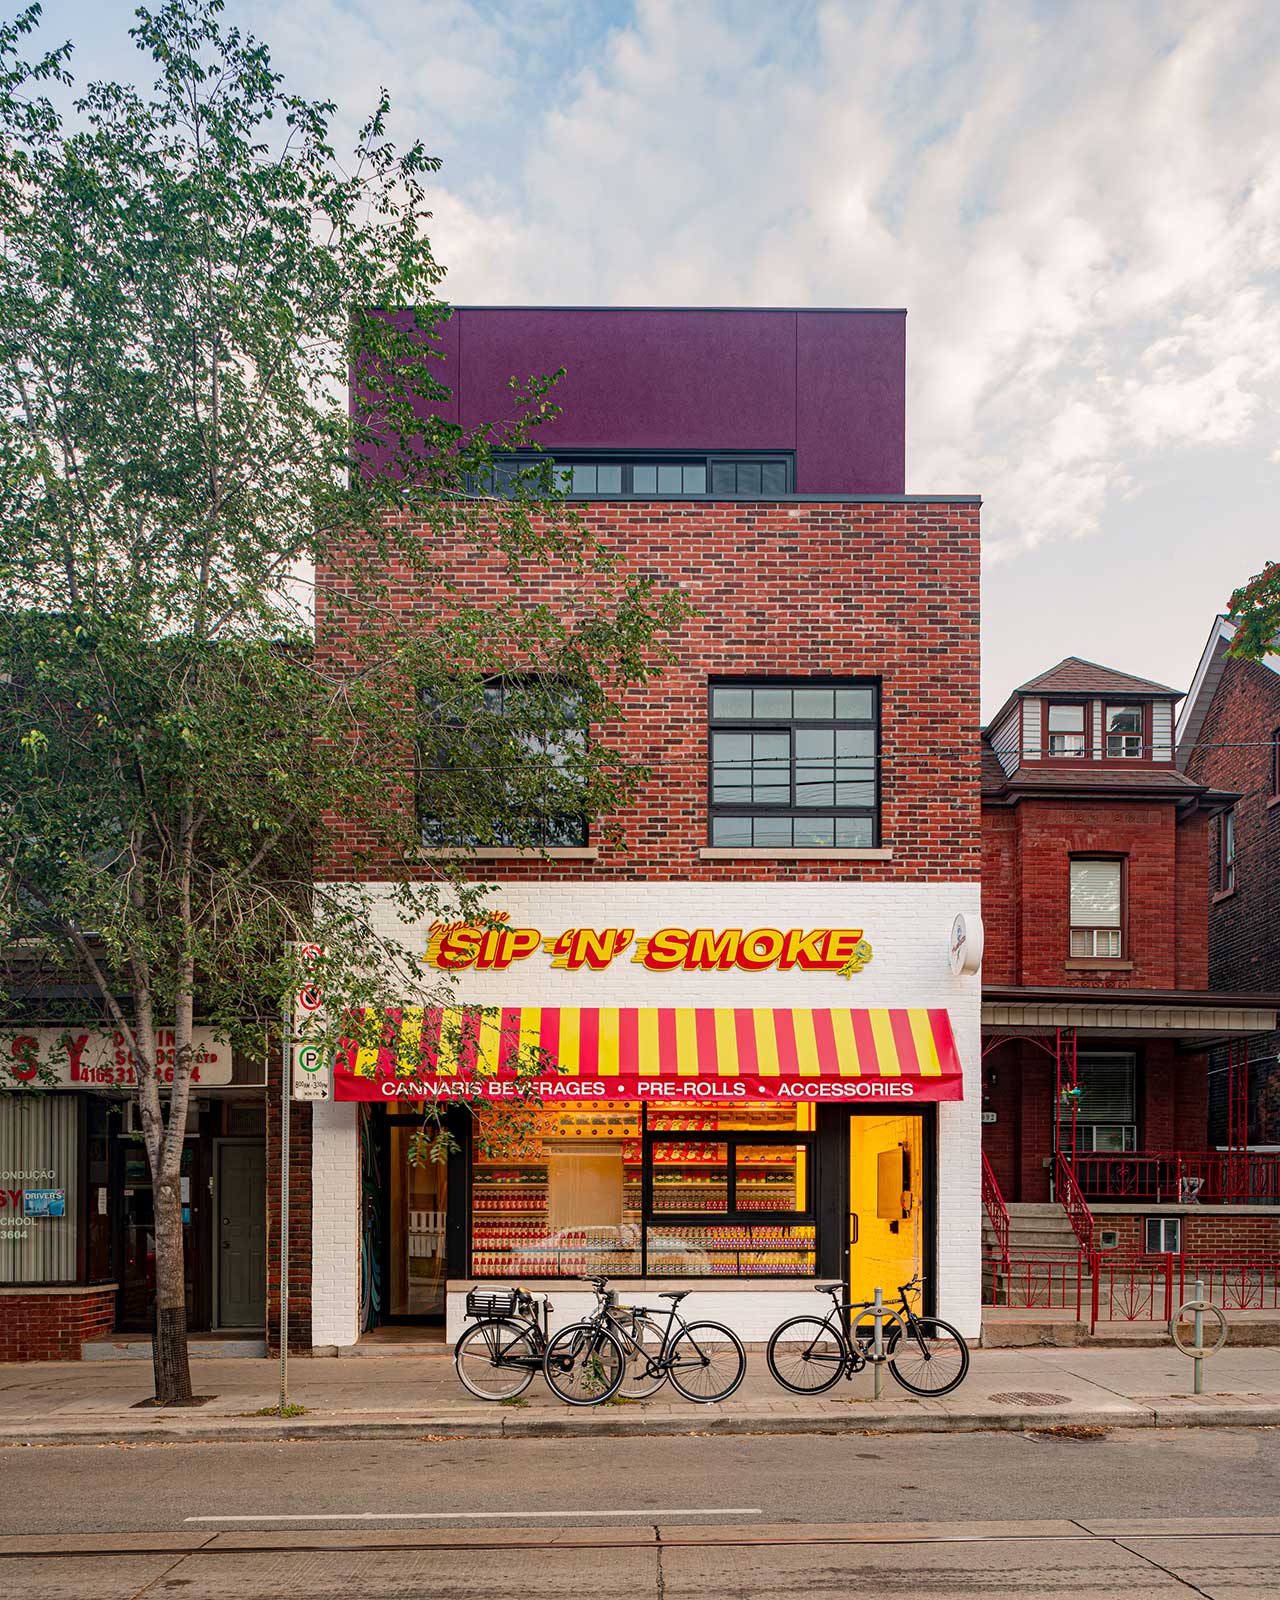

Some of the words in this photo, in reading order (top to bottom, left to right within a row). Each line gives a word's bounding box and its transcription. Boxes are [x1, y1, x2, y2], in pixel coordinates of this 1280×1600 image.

[436, 928, 541, 969] SIP
[643, 928, 864, 970] SMOKE
[306, 1053, 316, 1066] P
[381, 1082, 483, 1096] CANNABIS
[488, 1081, 606, 1096] BEVERAGES
[637, 1082, 746, 1096] PRE-ROLLS
[777, 1082, 914, 1097] ACCESSORIES
[0, 1168, 56, 1181] ONDUÇÃO
